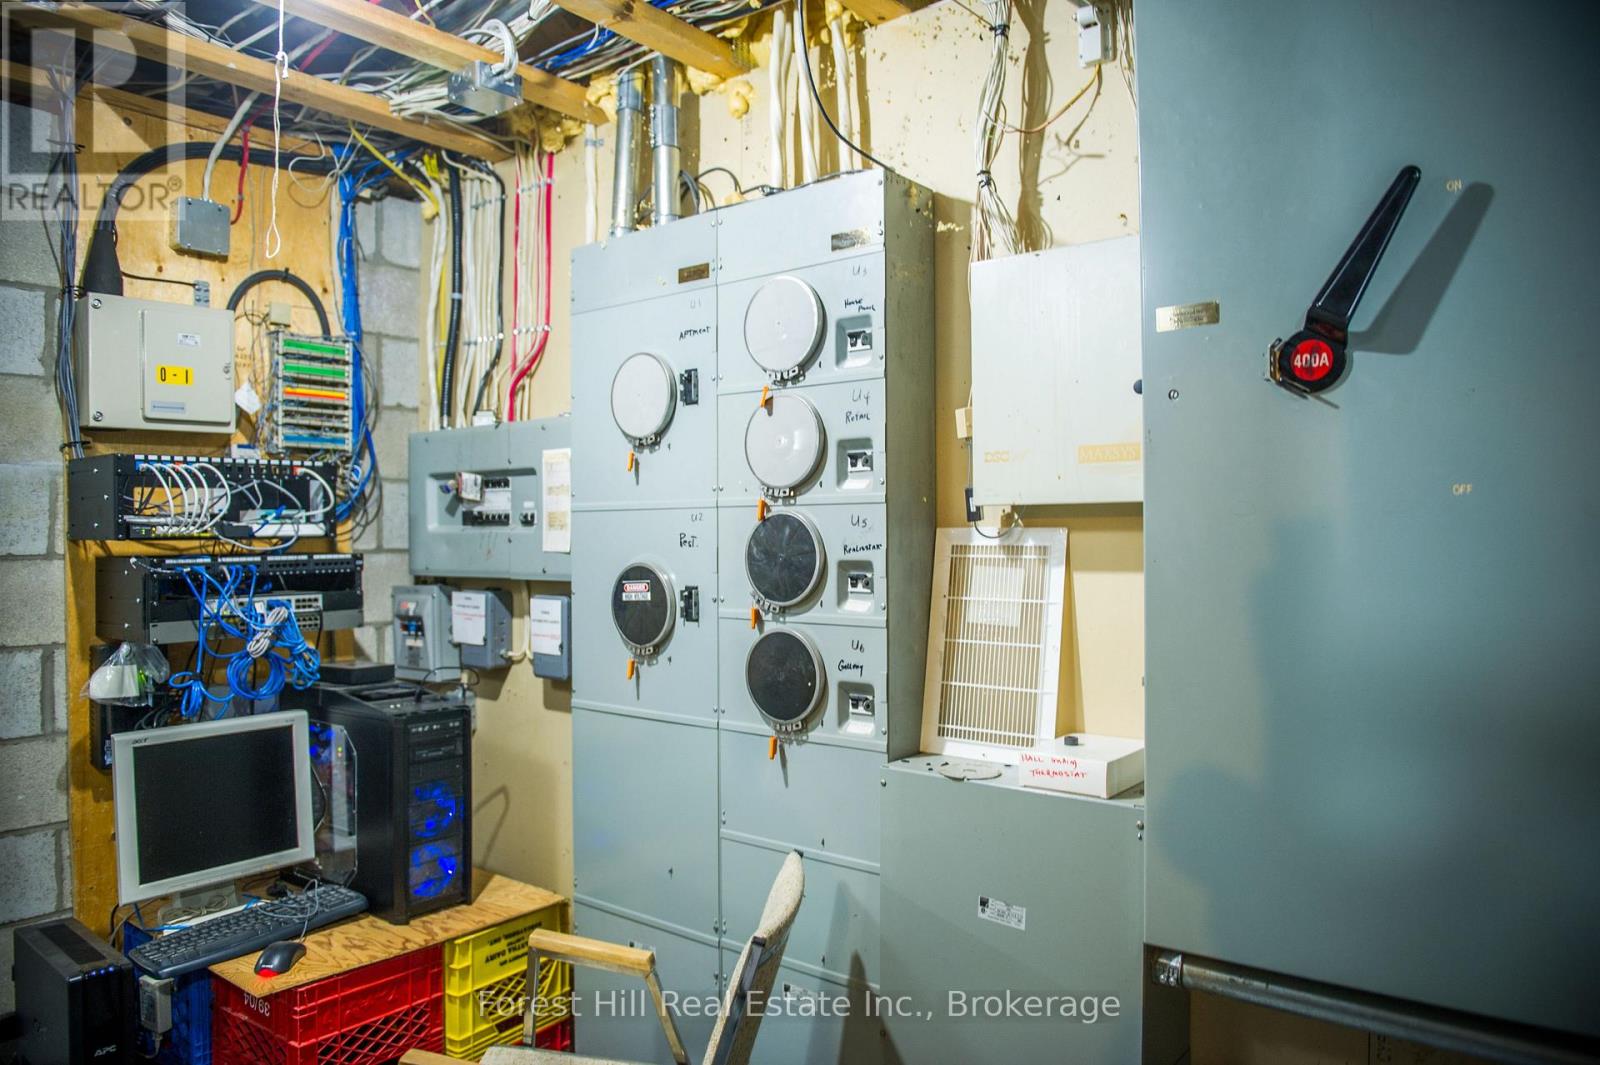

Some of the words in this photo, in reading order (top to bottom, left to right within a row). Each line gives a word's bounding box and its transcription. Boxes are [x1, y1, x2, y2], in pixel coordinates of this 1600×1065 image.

[1293, 352, 1330, 369] 400A
[851, 387, 870, 406] U4
[94, 1044, 117, 1058] APC
